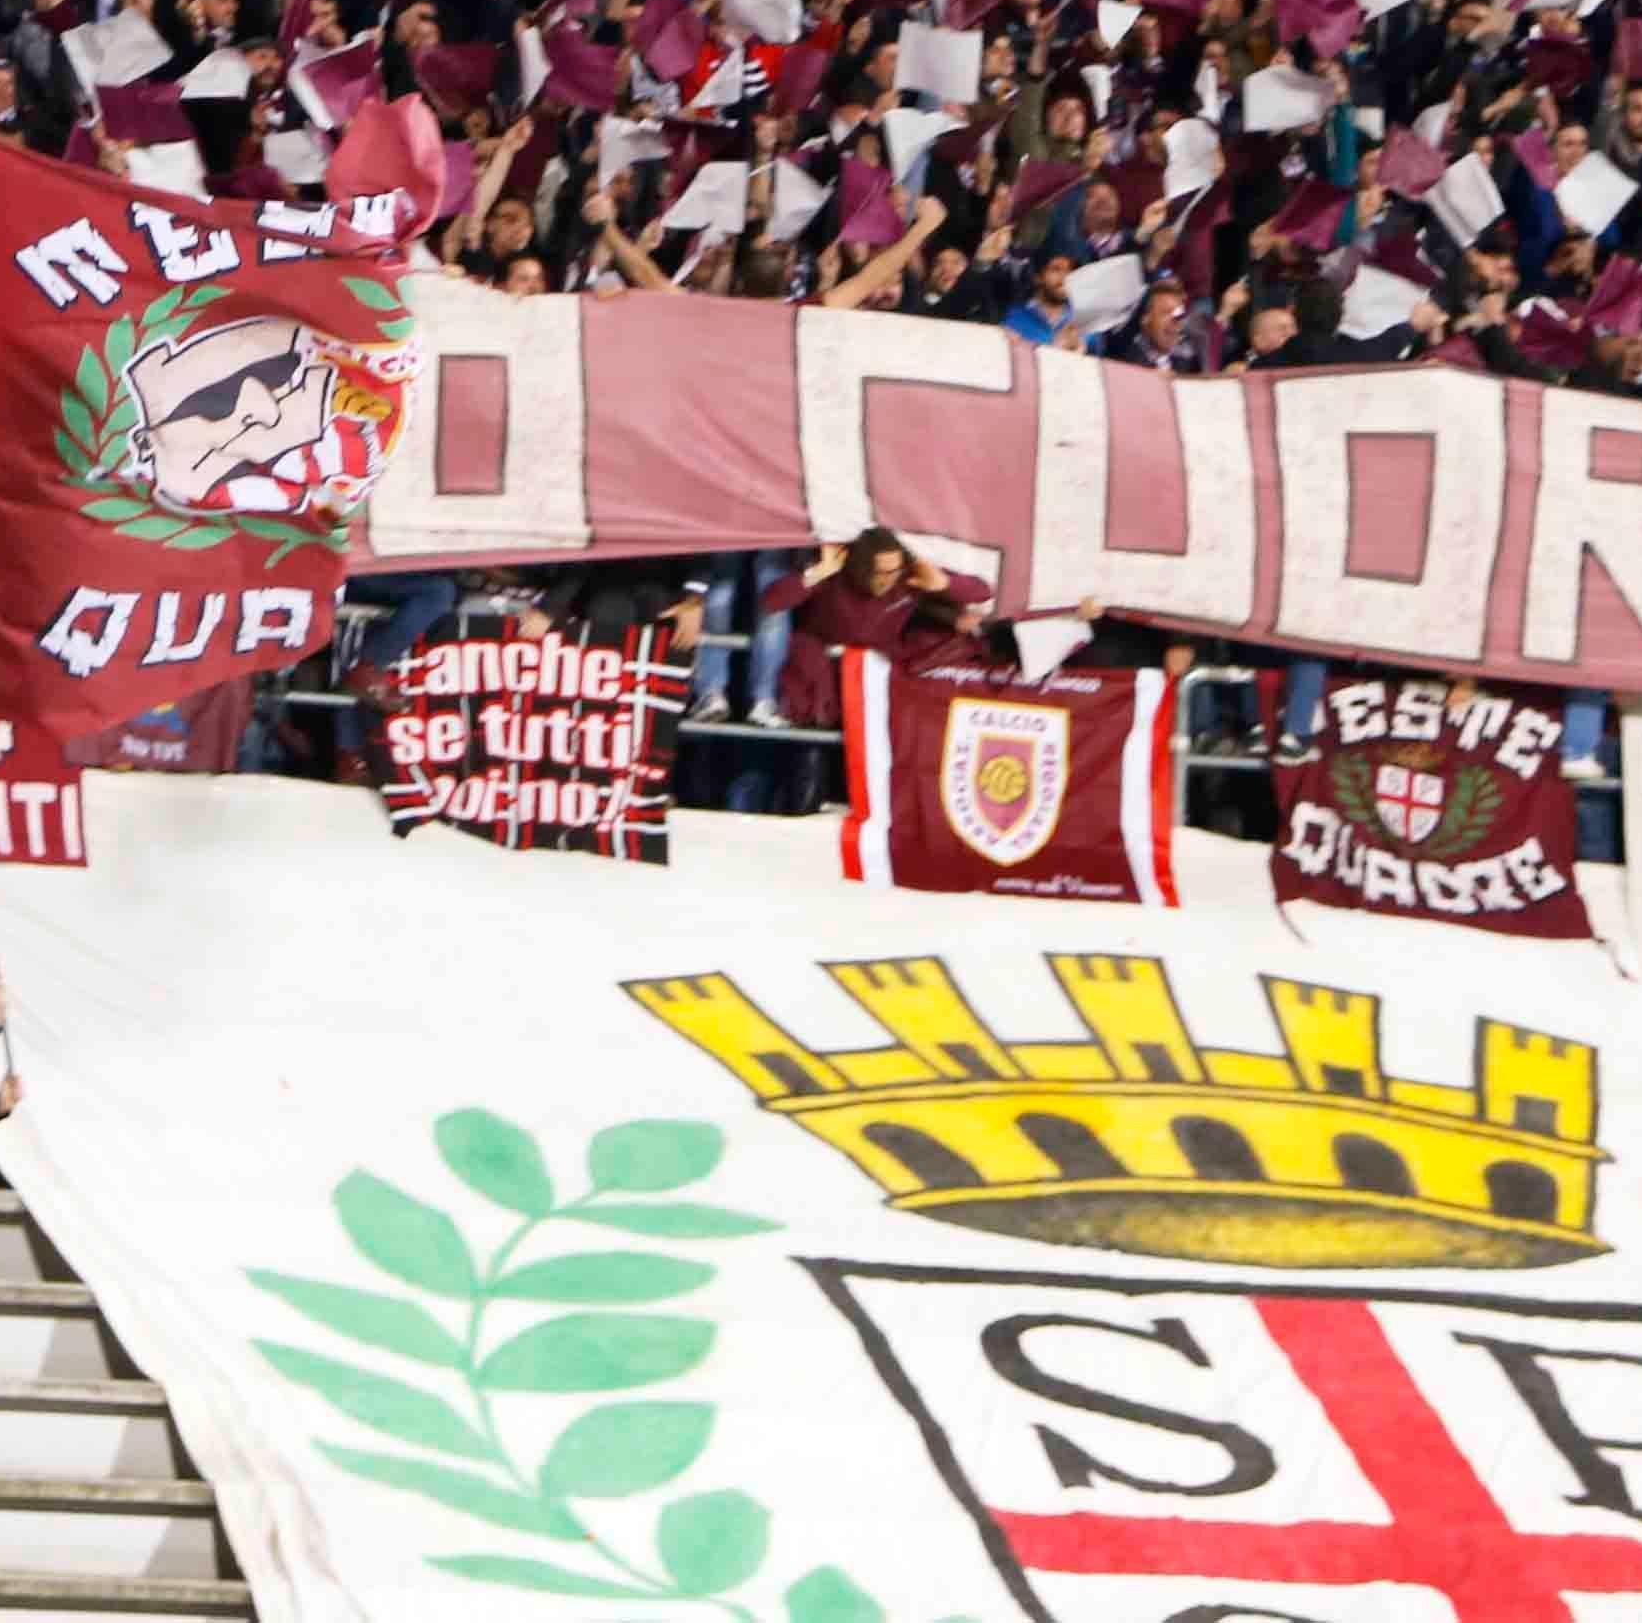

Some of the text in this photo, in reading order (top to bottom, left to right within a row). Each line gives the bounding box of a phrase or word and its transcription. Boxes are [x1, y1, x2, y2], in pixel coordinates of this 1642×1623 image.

[38, 585, 344, 679] QUA
[424, 632, 623, 701] anche
[387, 713, 466, 765] se
[980, 1312, 1276, 1497] S
